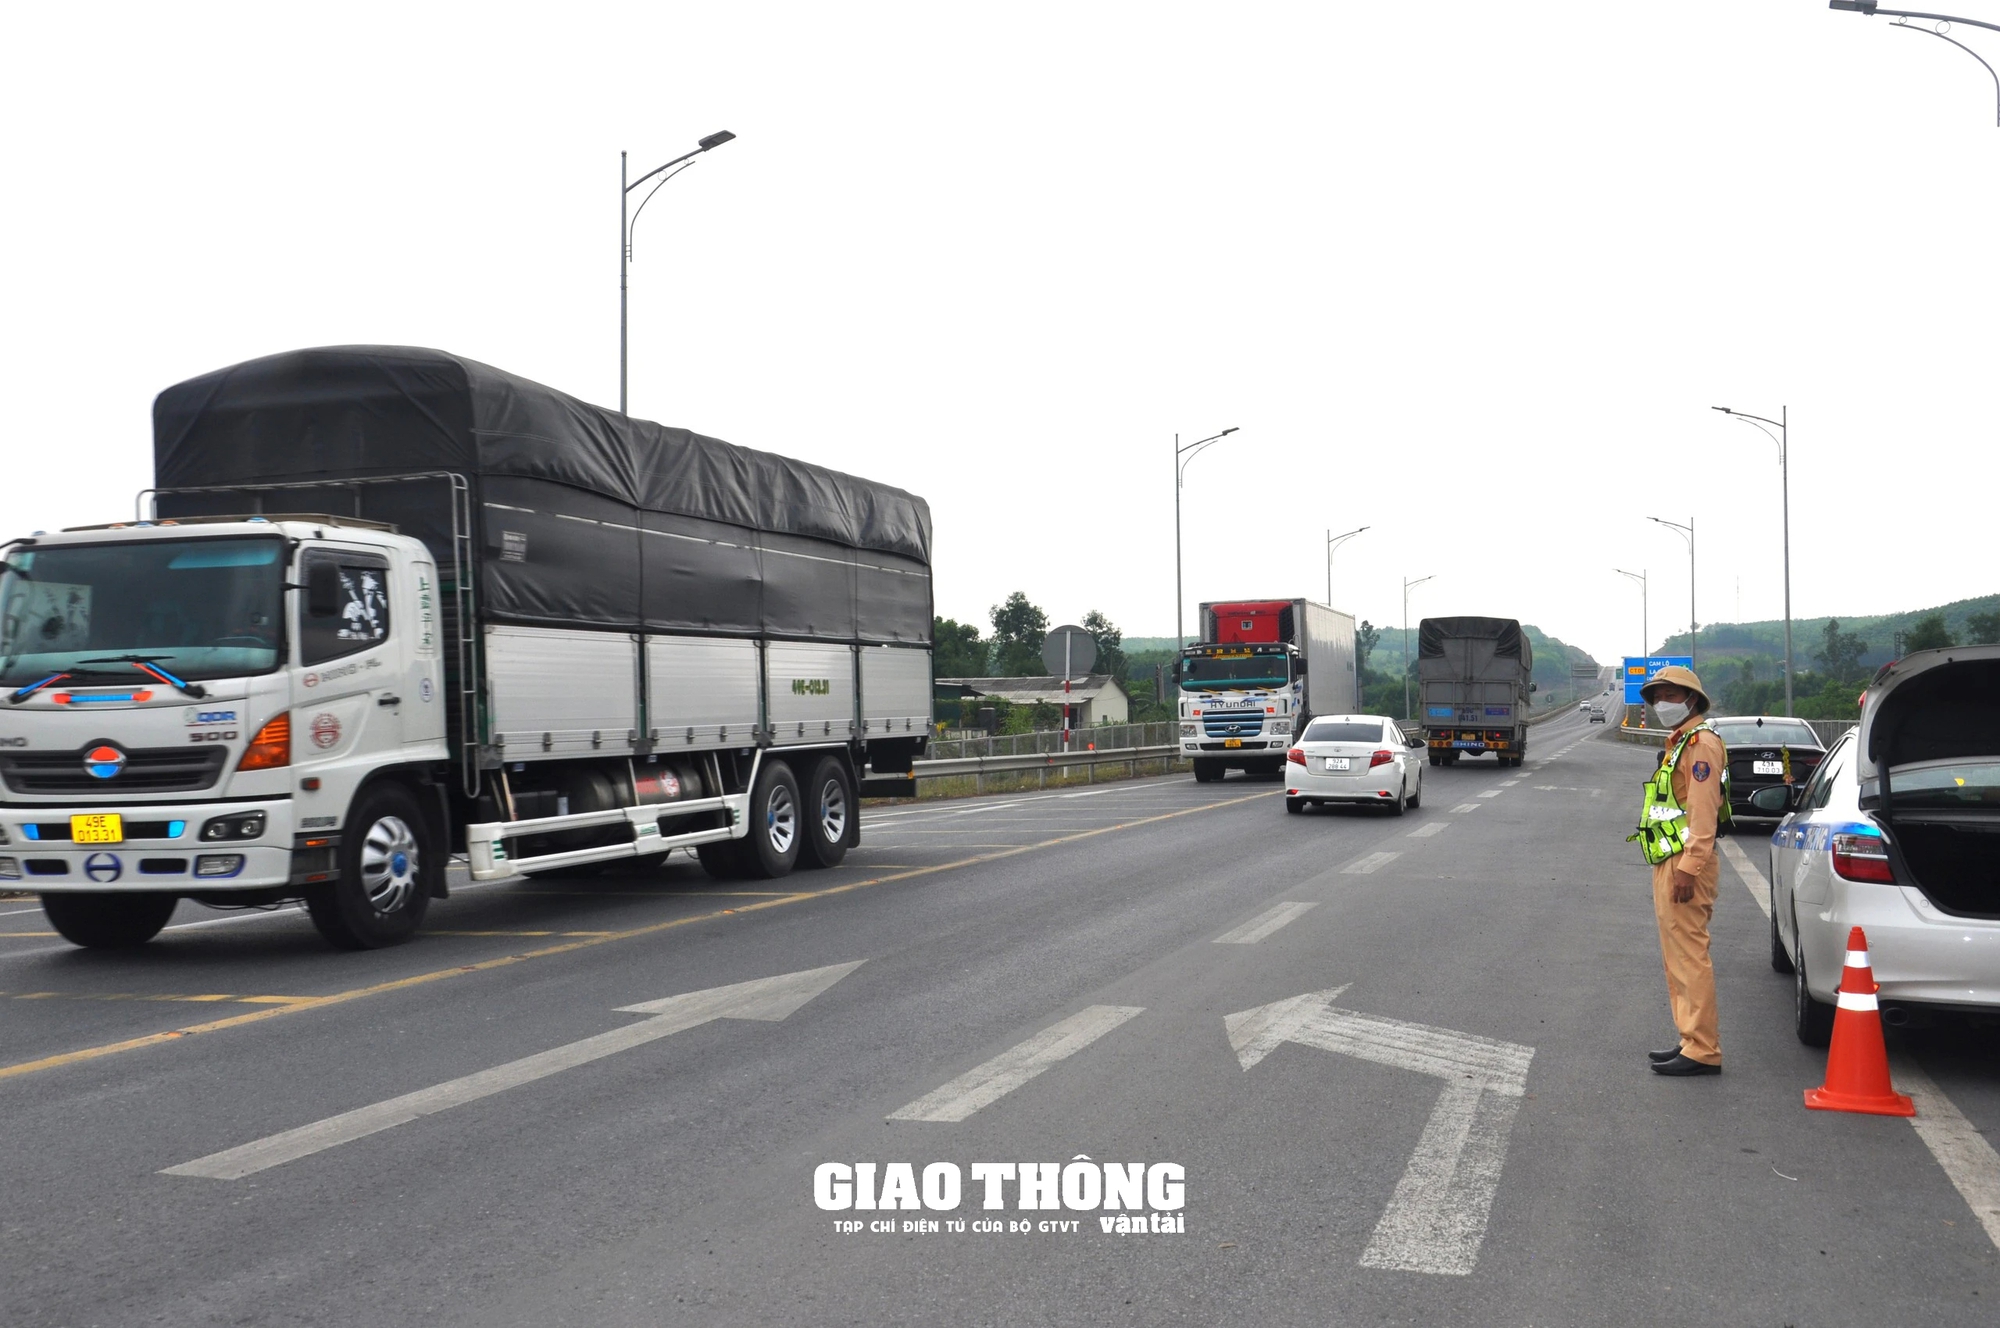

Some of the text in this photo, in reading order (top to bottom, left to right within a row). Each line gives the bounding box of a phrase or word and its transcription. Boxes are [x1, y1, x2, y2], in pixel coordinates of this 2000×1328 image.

[189, 731, 238, 742] 500
[86, 816, 106, 827] 49E
[78, 829, 116, 842] 013.31
